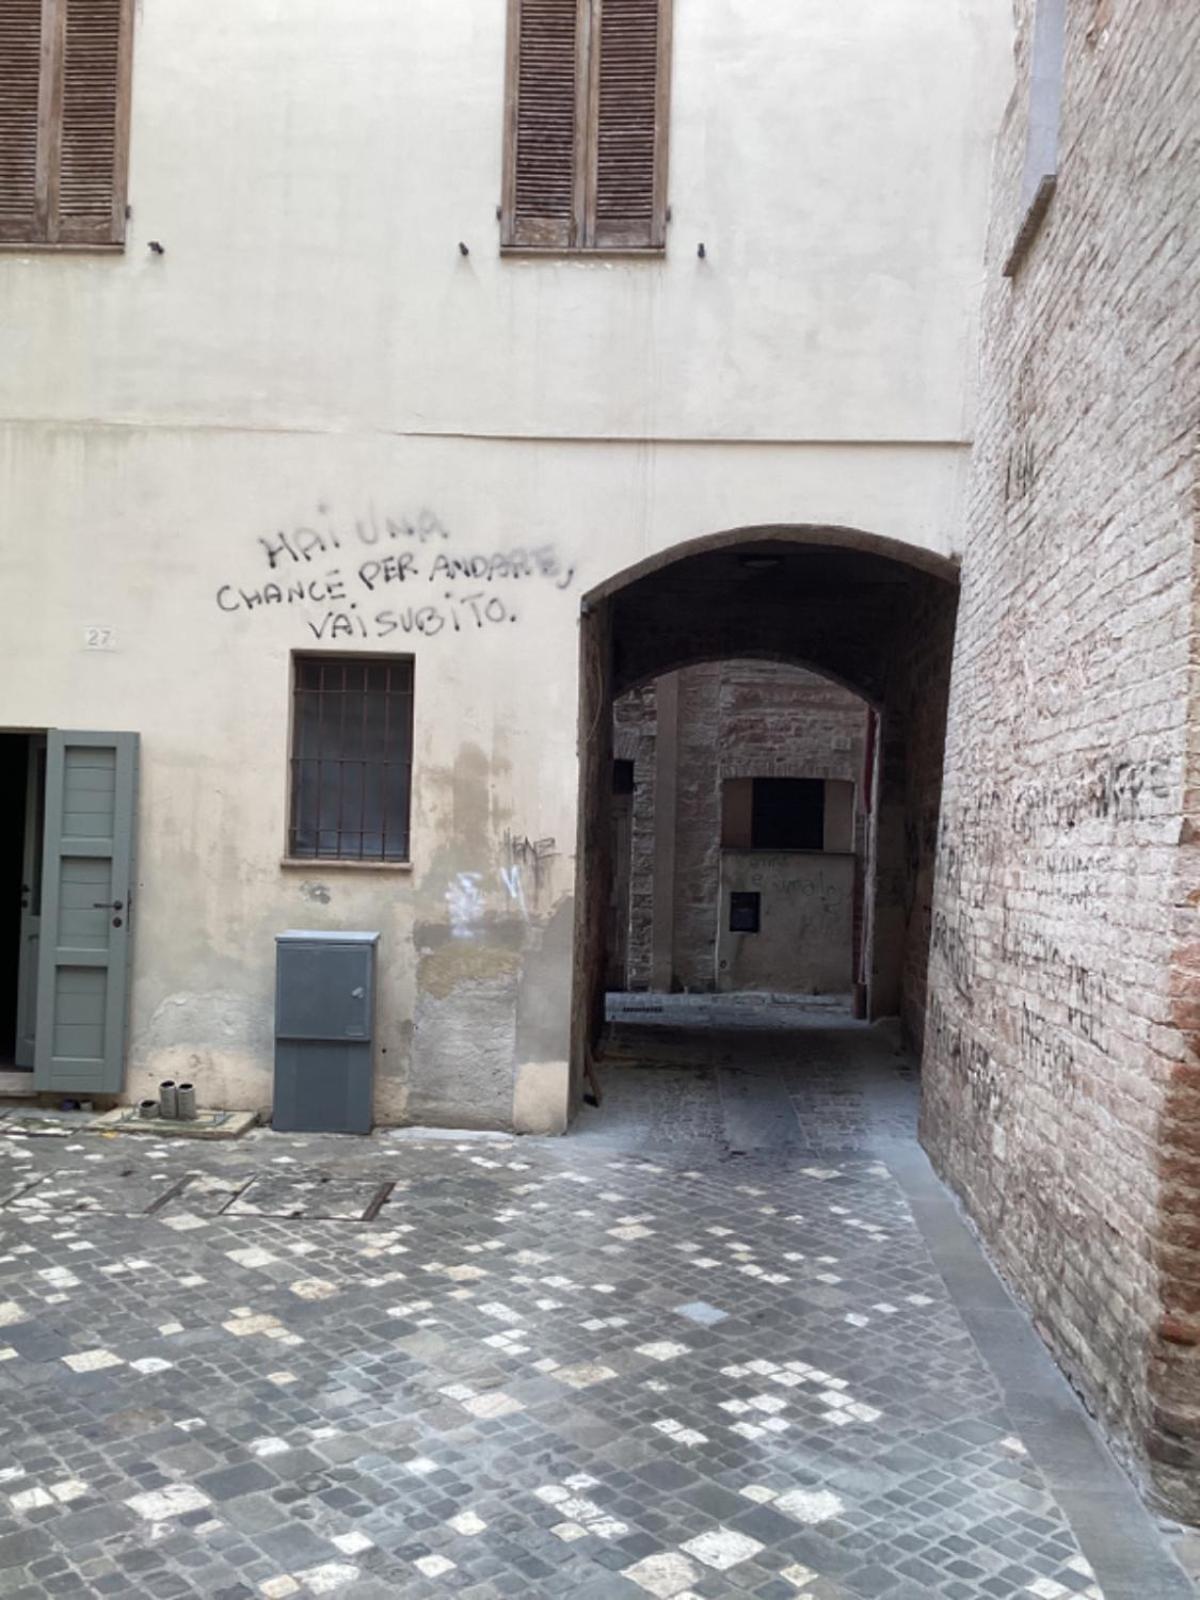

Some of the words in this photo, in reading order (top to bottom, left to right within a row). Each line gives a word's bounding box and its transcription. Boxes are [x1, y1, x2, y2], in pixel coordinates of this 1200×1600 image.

[216, 570, 347, 612] CHANCE
[358, 552, 419, 591] PER
[88, 629, 111, 645] 27
